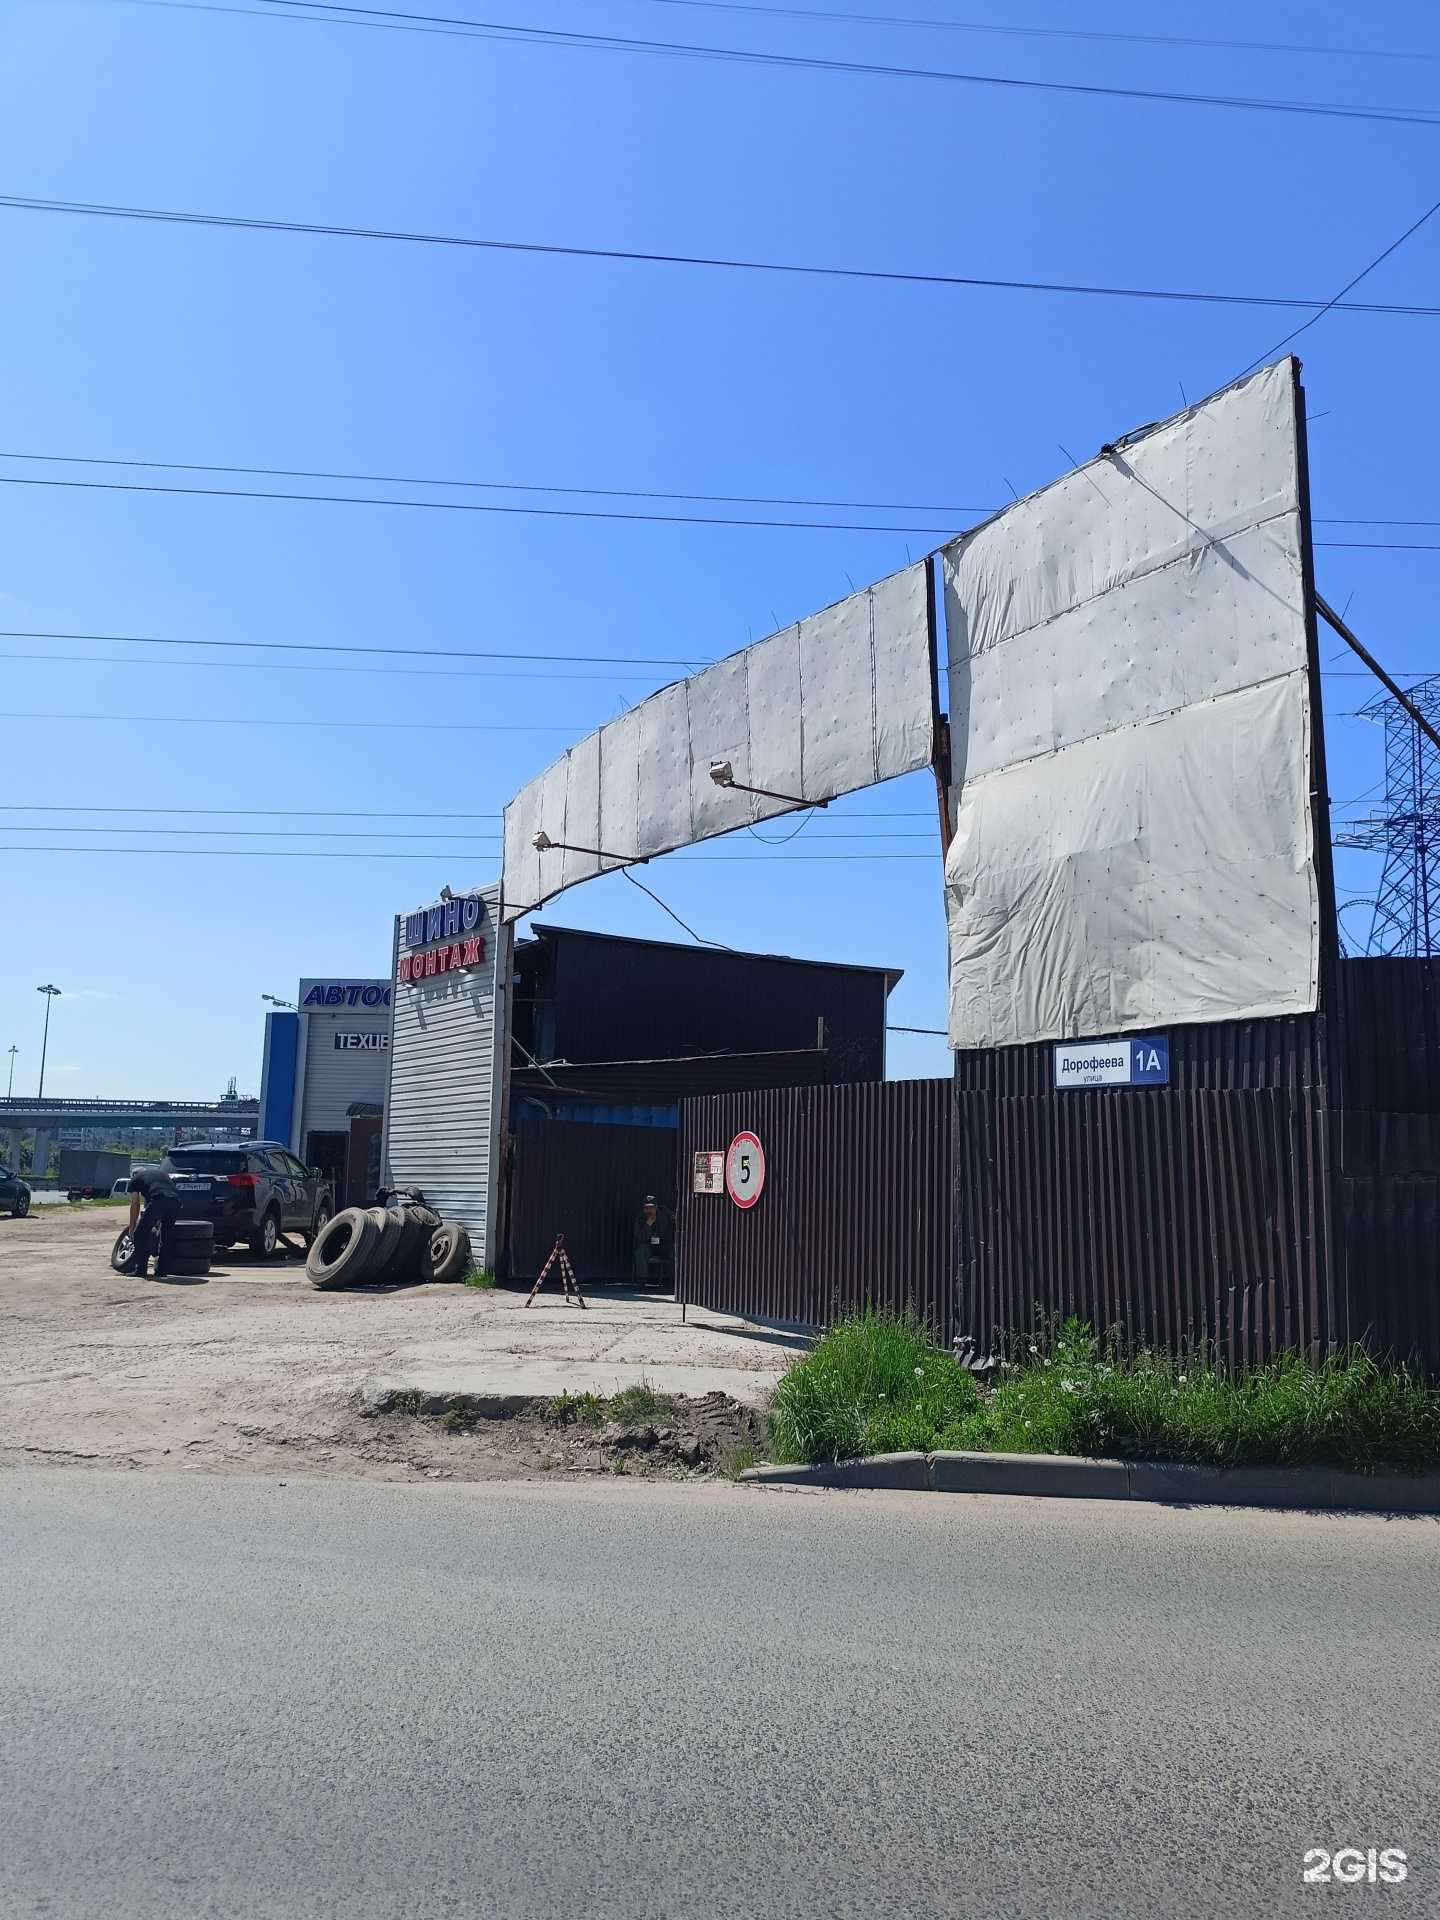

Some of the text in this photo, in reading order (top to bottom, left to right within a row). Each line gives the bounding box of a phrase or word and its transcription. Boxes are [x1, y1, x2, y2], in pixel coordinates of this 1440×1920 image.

[405, 893, 482, 948] ШИНО
[399, 937, 482, 981] МОНТАЖ
[1062, 1049, 1161, 1073] Дорофеева 1А
[1083, 1074, 1103, 1082] улица
[741, 1155, 751, 1184] 5
